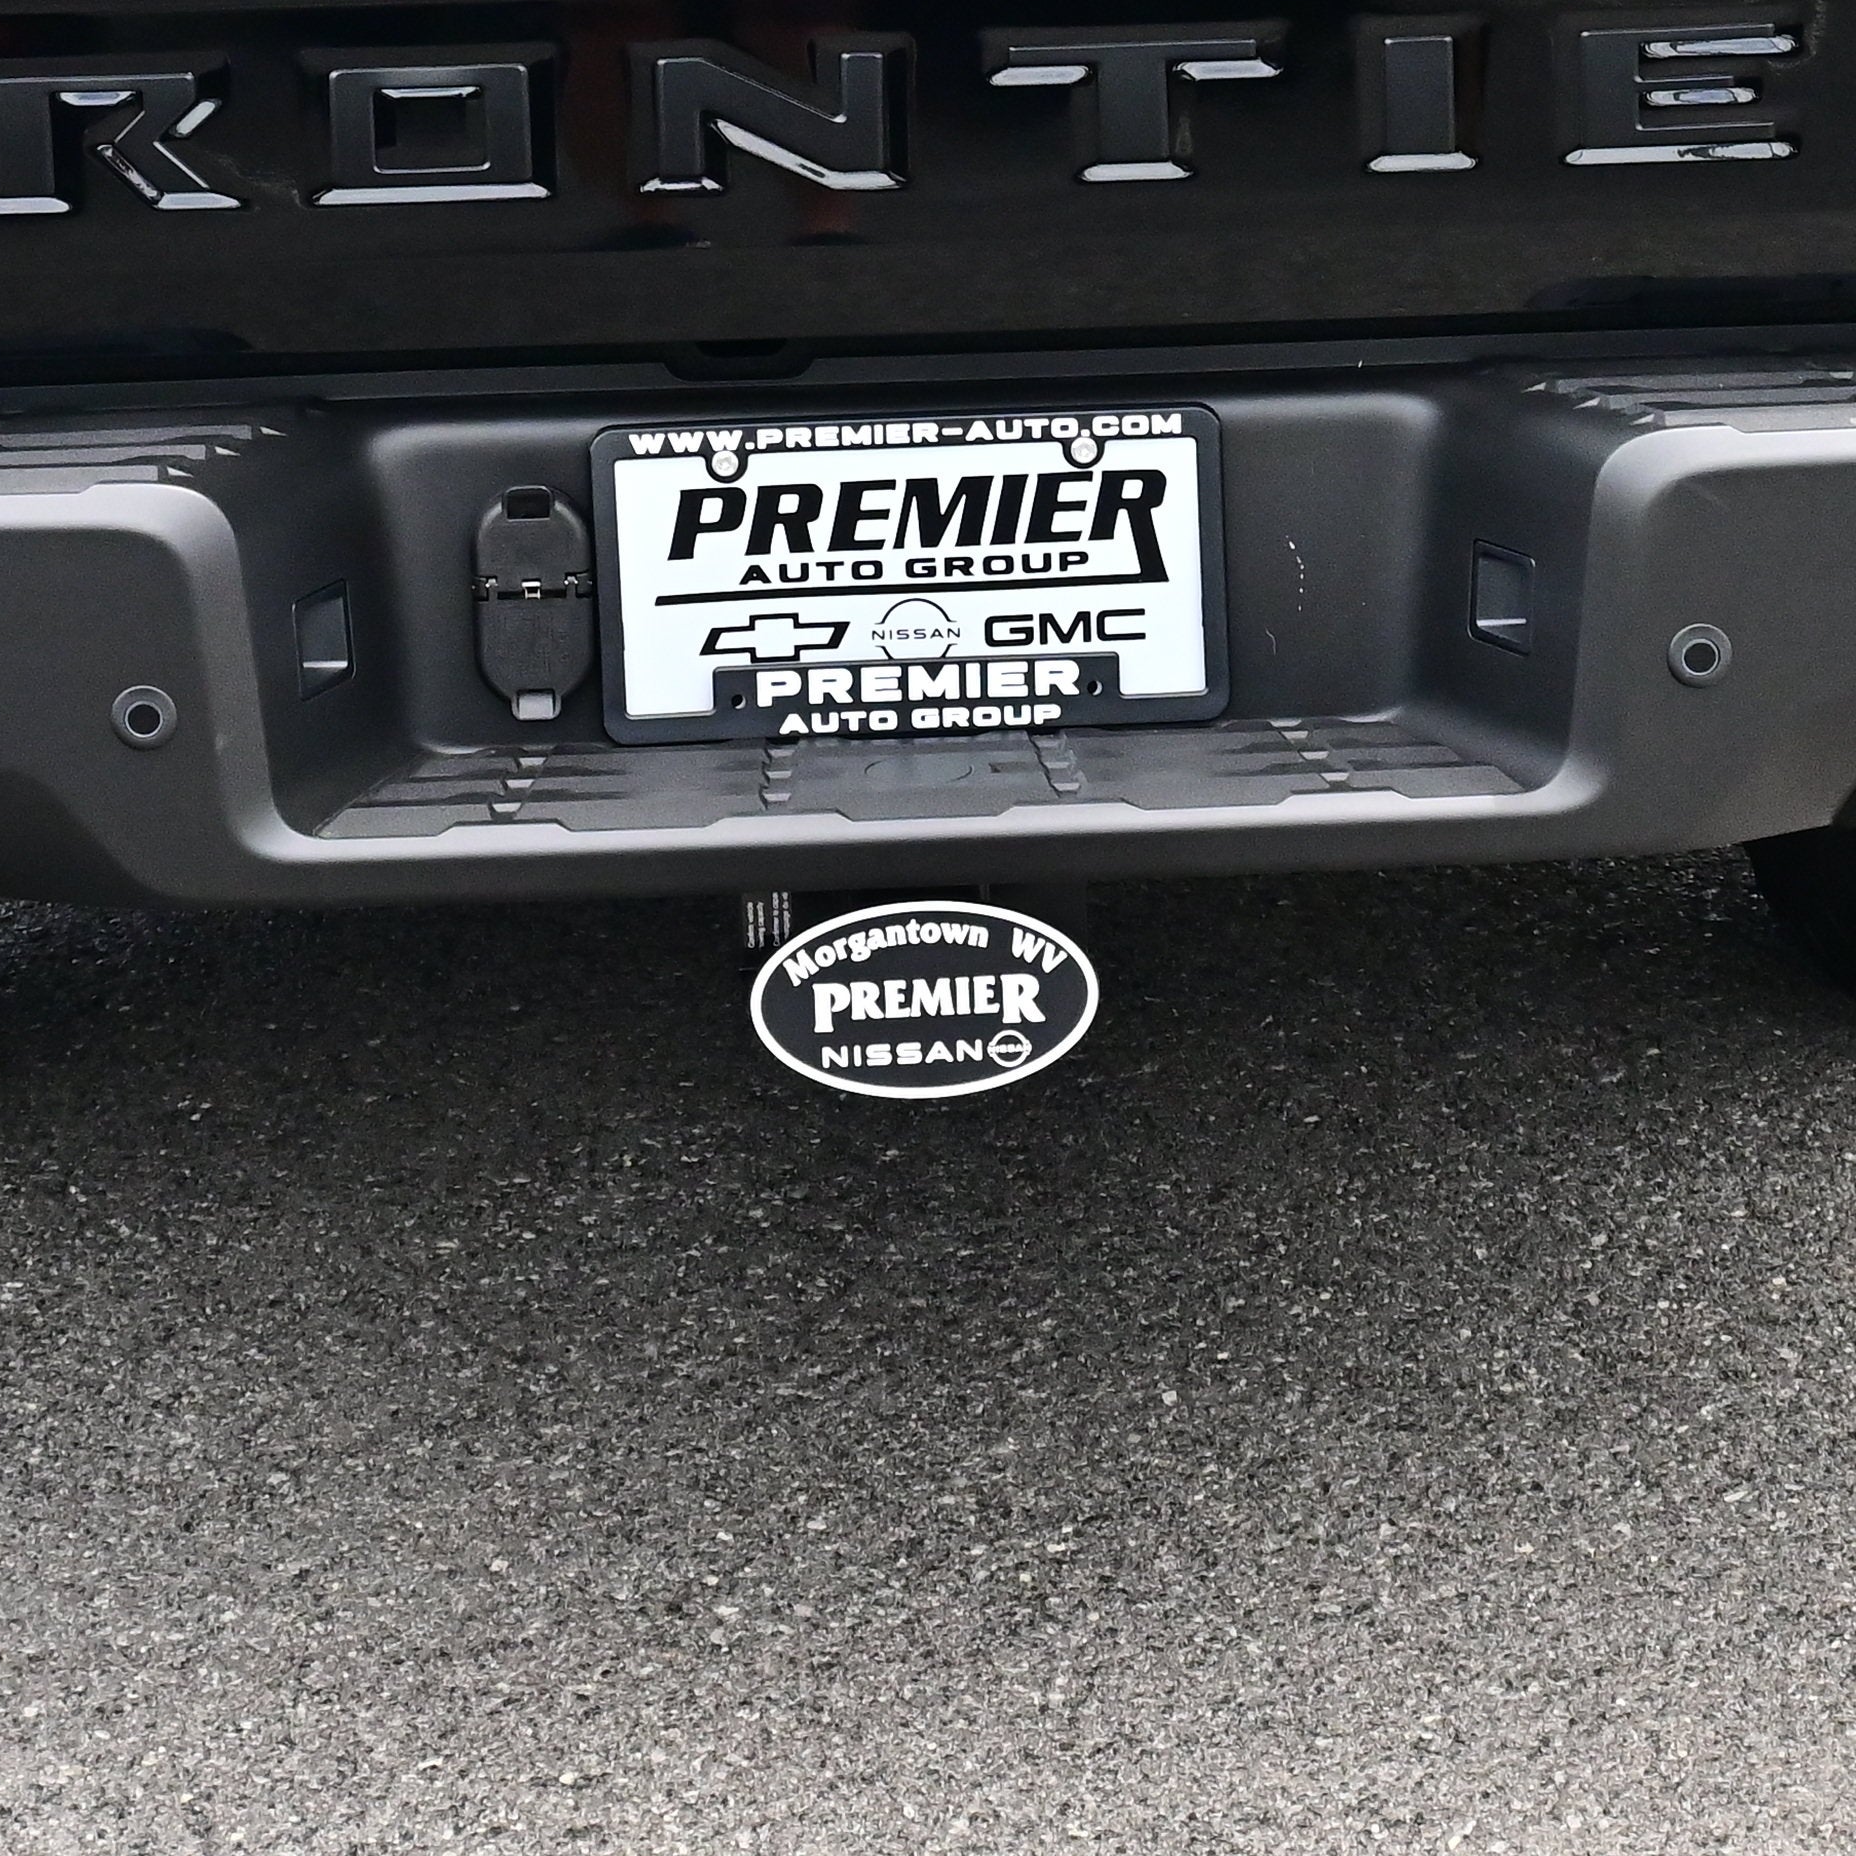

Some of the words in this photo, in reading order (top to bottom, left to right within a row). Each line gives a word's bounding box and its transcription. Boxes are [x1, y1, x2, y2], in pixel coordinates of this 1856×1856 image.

[628, 413, 1182, 455] WWW.PREMIER-AUTO.COM
[666, 469, 1169, 582] PREMIER
[739, 557, 884, 586] AUTO
[905, 550, 1090, 579] GROUP
[871, 625, 961, 641] NISSAN
[984, 608, 1146, 648] GMC
[755, 659, 1081, 708] PREMIER
[779, 709, 898, 735] AUTO
[911, 703, 1062, 729] GROUP
[782, 918, 990, 987] Morgantown
[1011, 927, 1068, 974] WV
[812, 973, 1046, 1033] PREMIER
[821, 1039, 983, 1069] NISSAN
